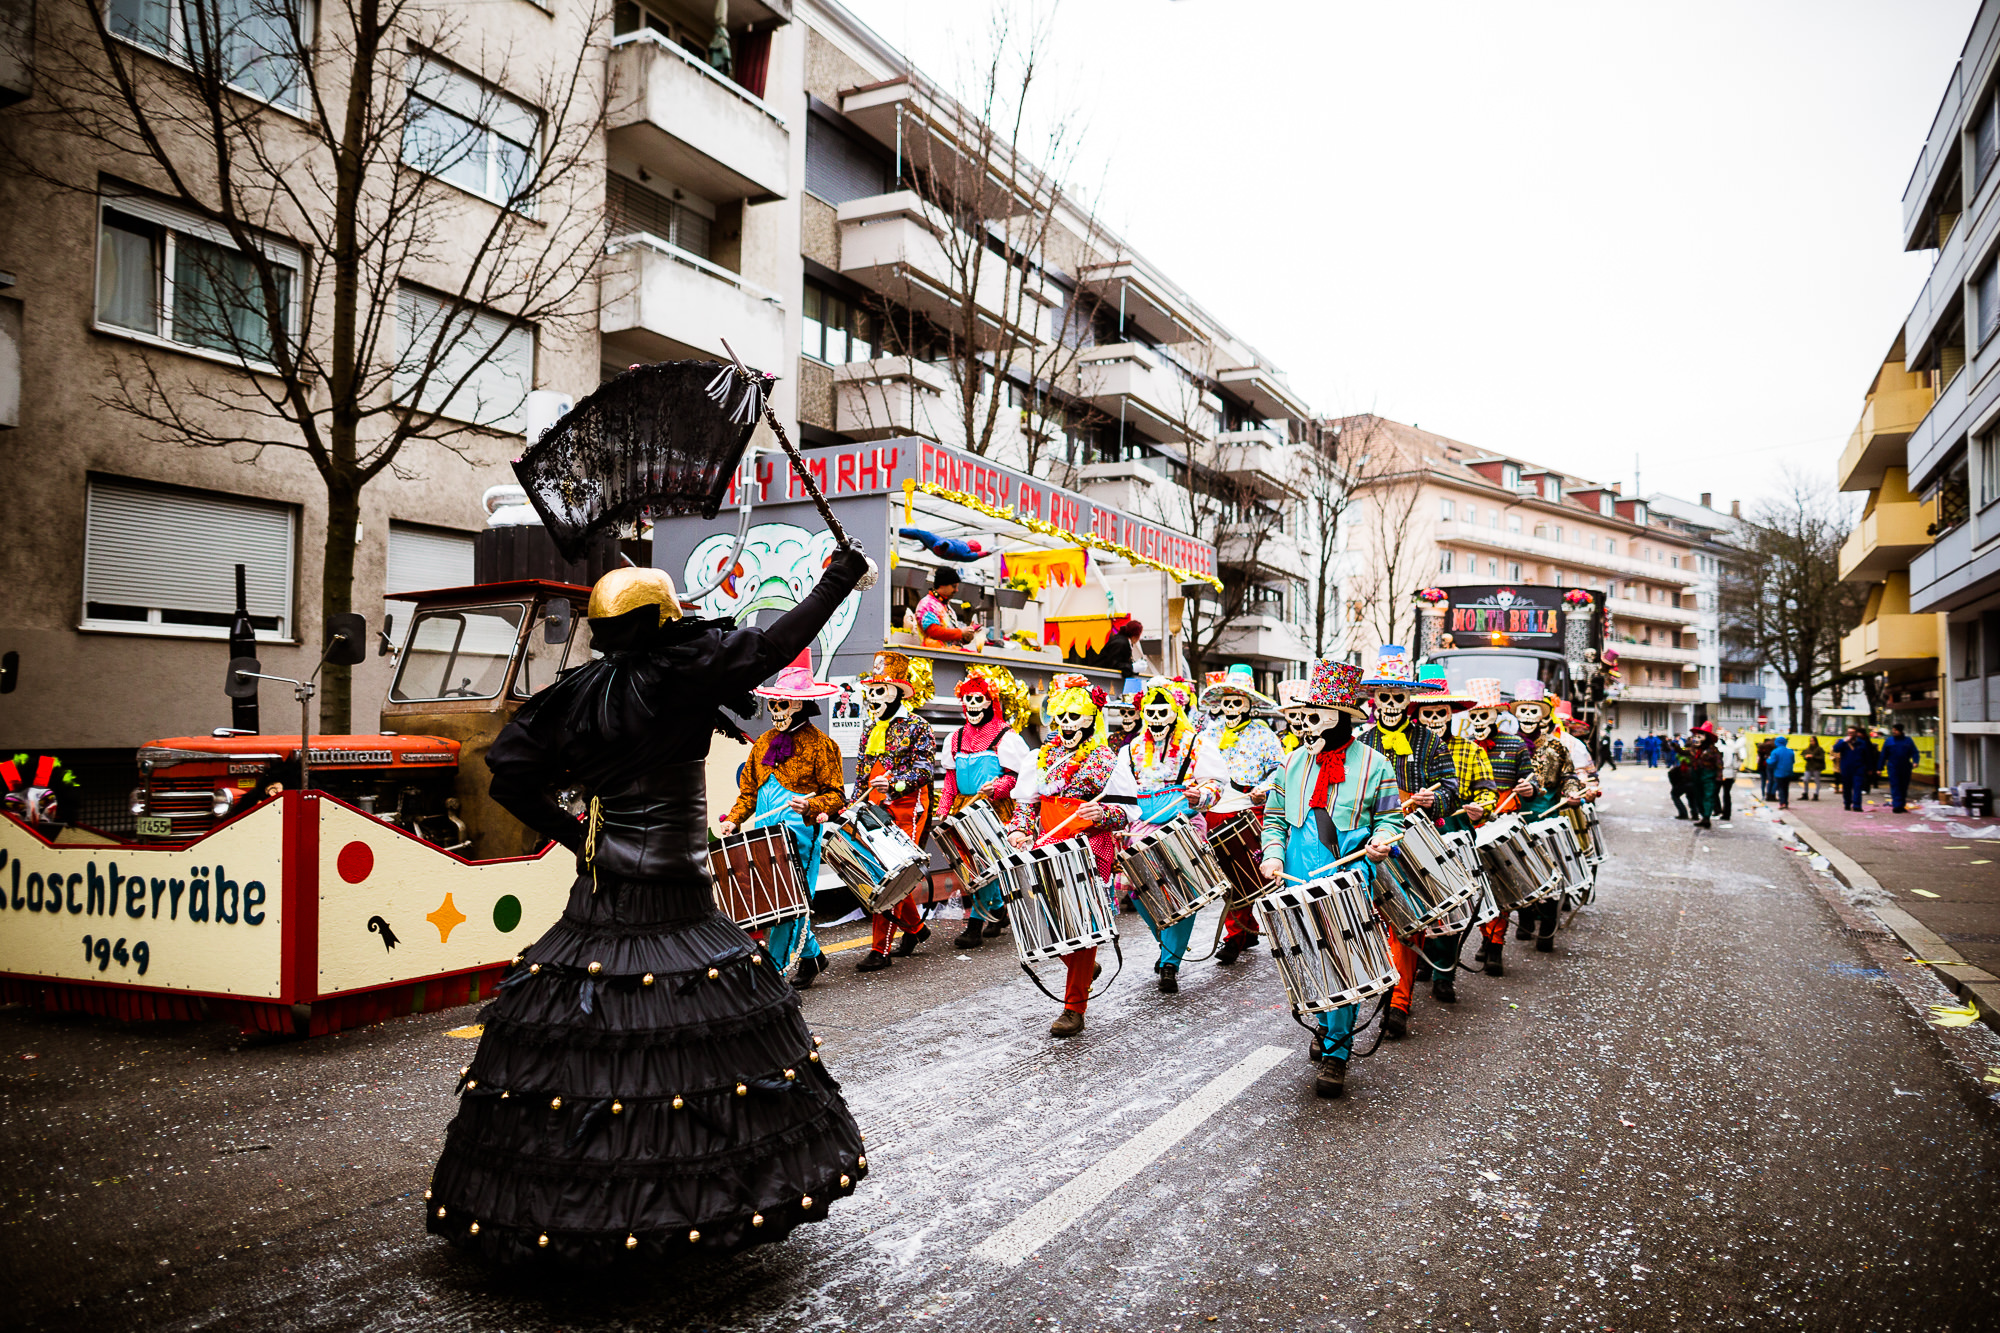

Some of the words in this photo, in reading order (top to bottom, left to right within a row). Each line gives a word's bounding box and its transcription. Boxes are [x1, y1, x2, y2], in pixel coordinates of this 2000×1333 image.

[786, 457, 827, 499] AM
[834, 447, 898, 494] RHY
[920, 442, 1010, 508] FANTASY
[1017, 482, 1042, 521] AM
[1049, 492, 1079, 534] RHY
[1452, 608, 1505, 632] MORTA
[1509, 609, 1558, 633] BELLA
[82, 934, 150, 976] 1949
